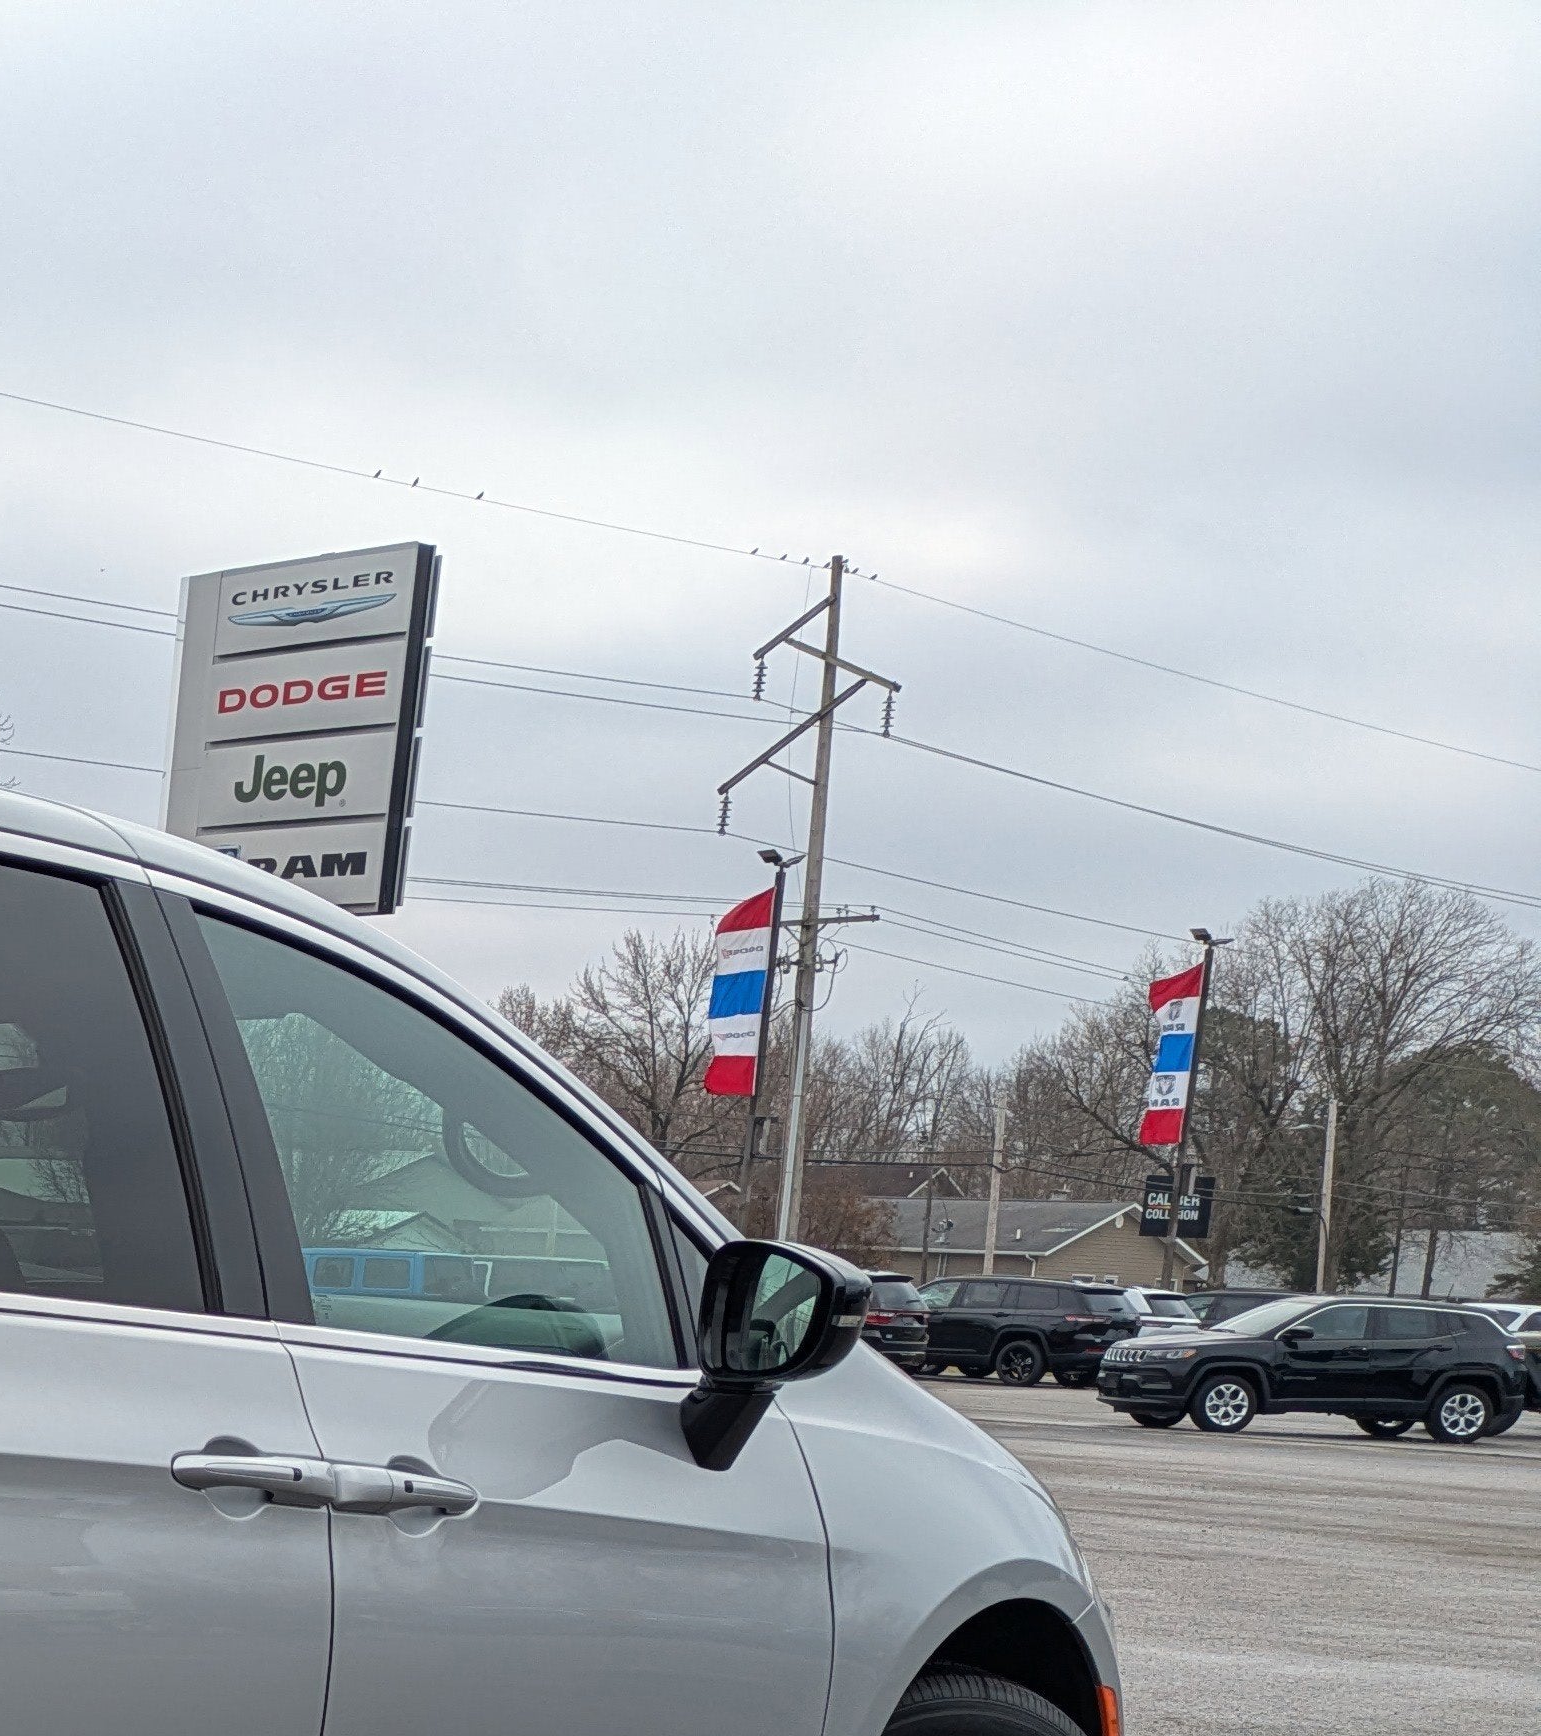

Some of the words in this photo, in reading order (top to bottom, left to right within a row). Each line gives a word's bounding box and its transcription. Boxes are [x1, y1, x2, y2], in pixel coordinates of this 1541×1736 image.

[231, 571, 394, 606] CHRYSLER
[218, 671, 388, 714] DODGE
[234, 754, 347, 807] Jeep
[1145, 1208, 1199, 1221] COLLION
[1147, 1192, 1200, 1207] CALER
